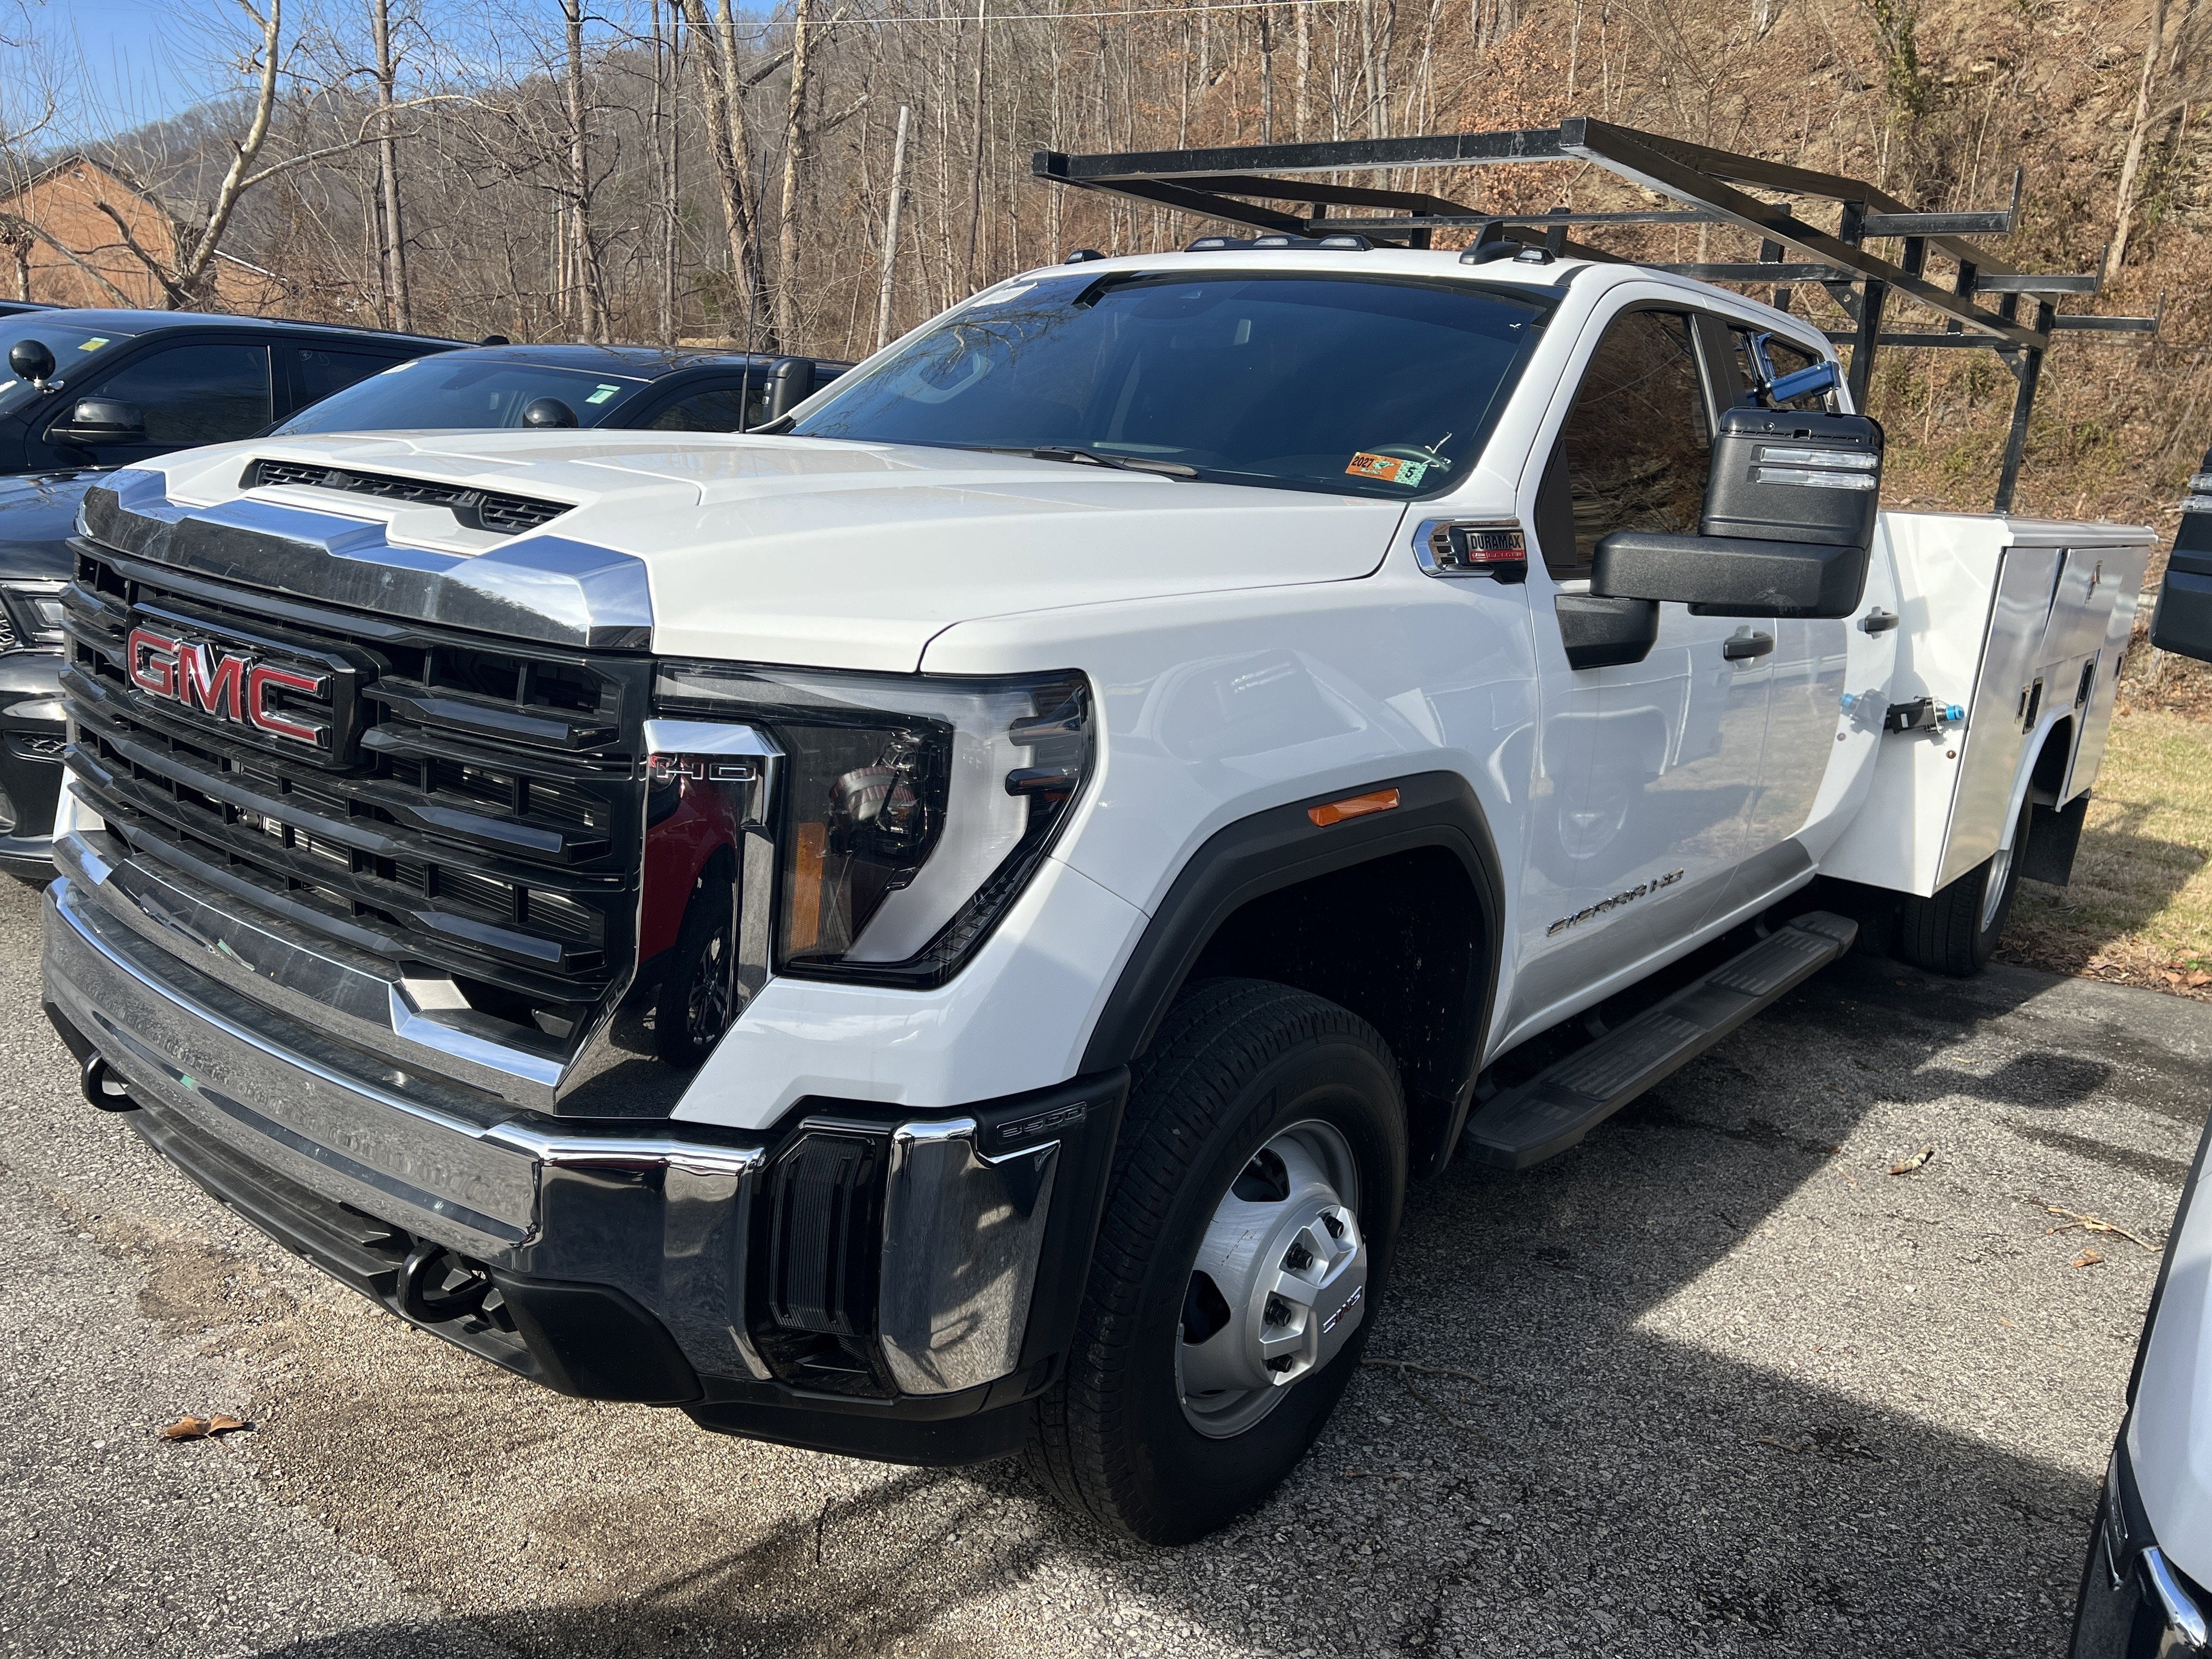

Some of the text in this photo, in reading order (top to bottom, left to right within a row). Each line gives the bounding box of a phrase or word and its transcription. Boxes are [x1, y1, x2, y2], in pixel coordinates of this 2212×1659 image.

[1351, 456, 1374, 469] 2027
[1405, 466, 1416, 478] 5
[1470, 534, 1521, 549] DURAMAX
[128, 624, 329, 748] GMC
[656, 762, 757, 781] HD
[1002, 1105, 1086, 1138] 3500
[1323, 1285, 1362, 1334] GMC
